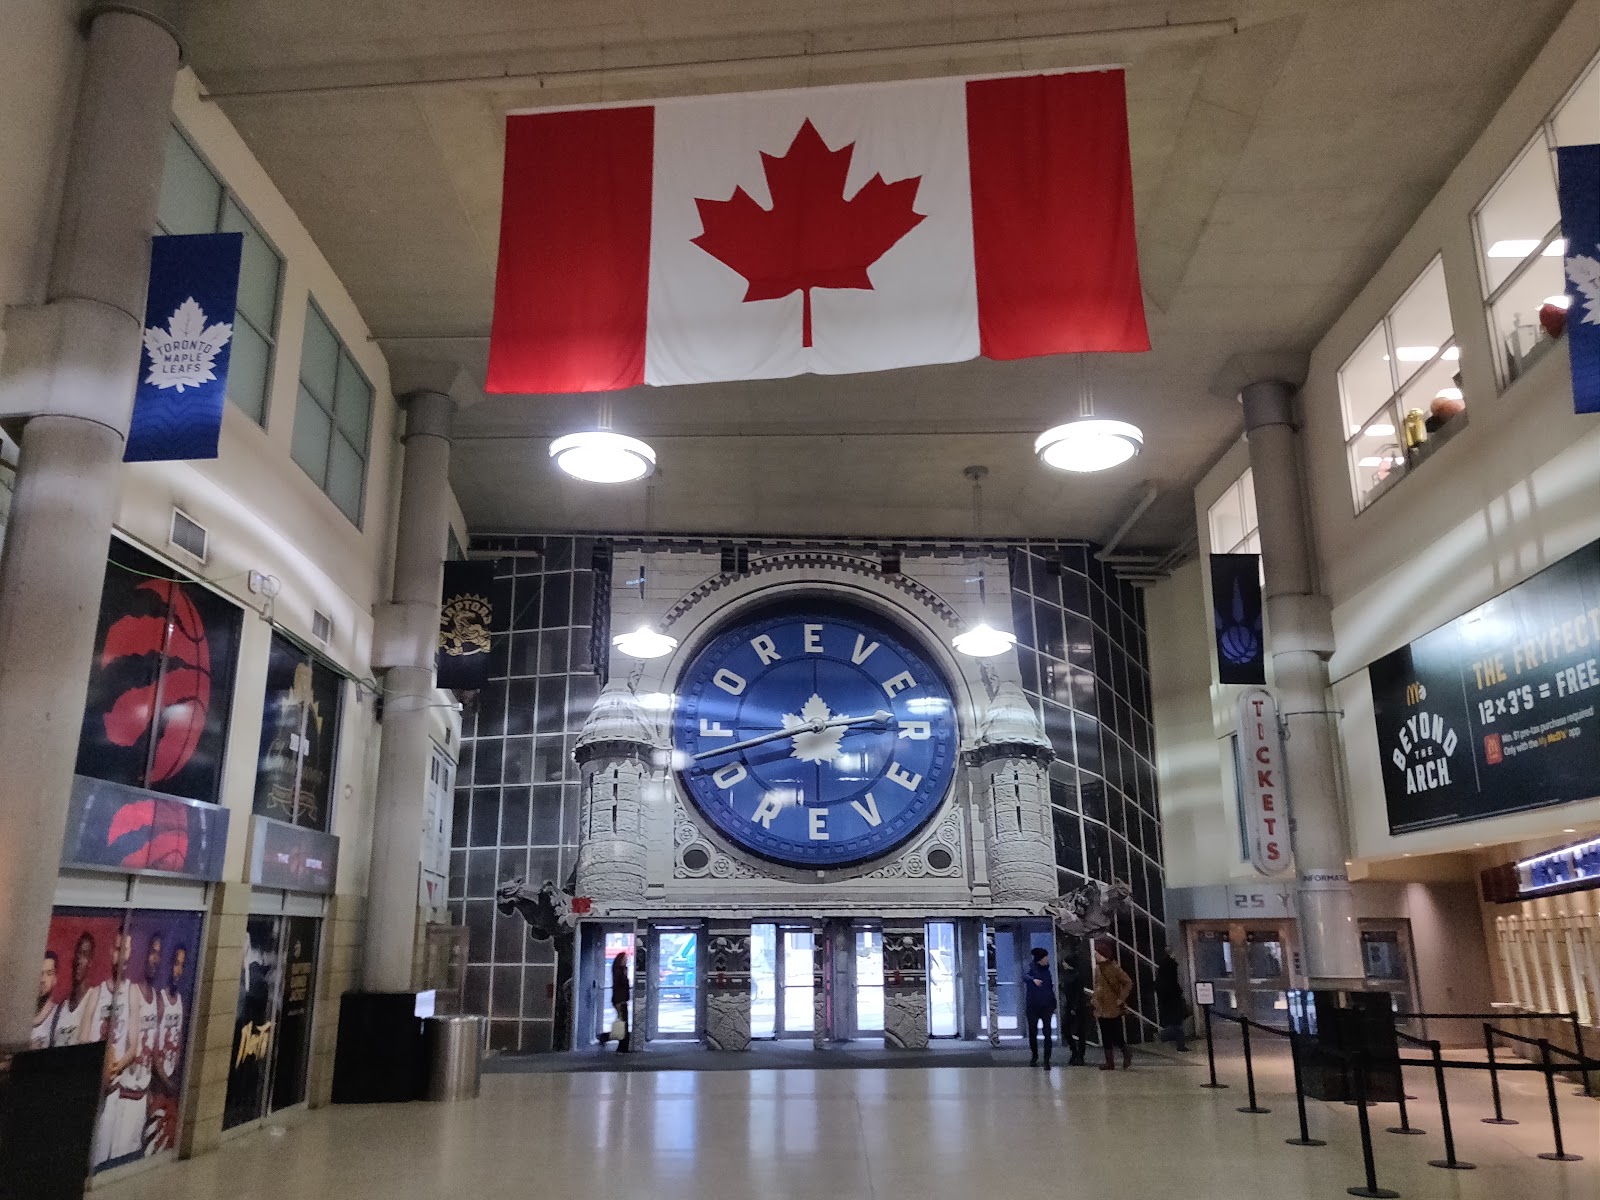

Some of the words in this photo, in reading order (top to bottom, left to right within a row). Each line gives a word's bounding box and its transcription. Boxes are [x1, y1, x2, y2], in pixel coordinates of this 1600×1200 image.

[157, 340, 213, 355] TORONTO
[164, 353, 202, 362] MAPLE
[162, 363, 201, 374] LEAFS
[1473, 653, 1507, 690] THE
[1555, 659, 1600, 697] FREE
[1392, 711, 1458, 771] BEYOND
[1414, 746, 1433, 760] THE
[1252, 700, 1281, 861] TICKETS
[1407, 757, 1451, 795] ARCH
[1234, 894, 1265, 908] 25
